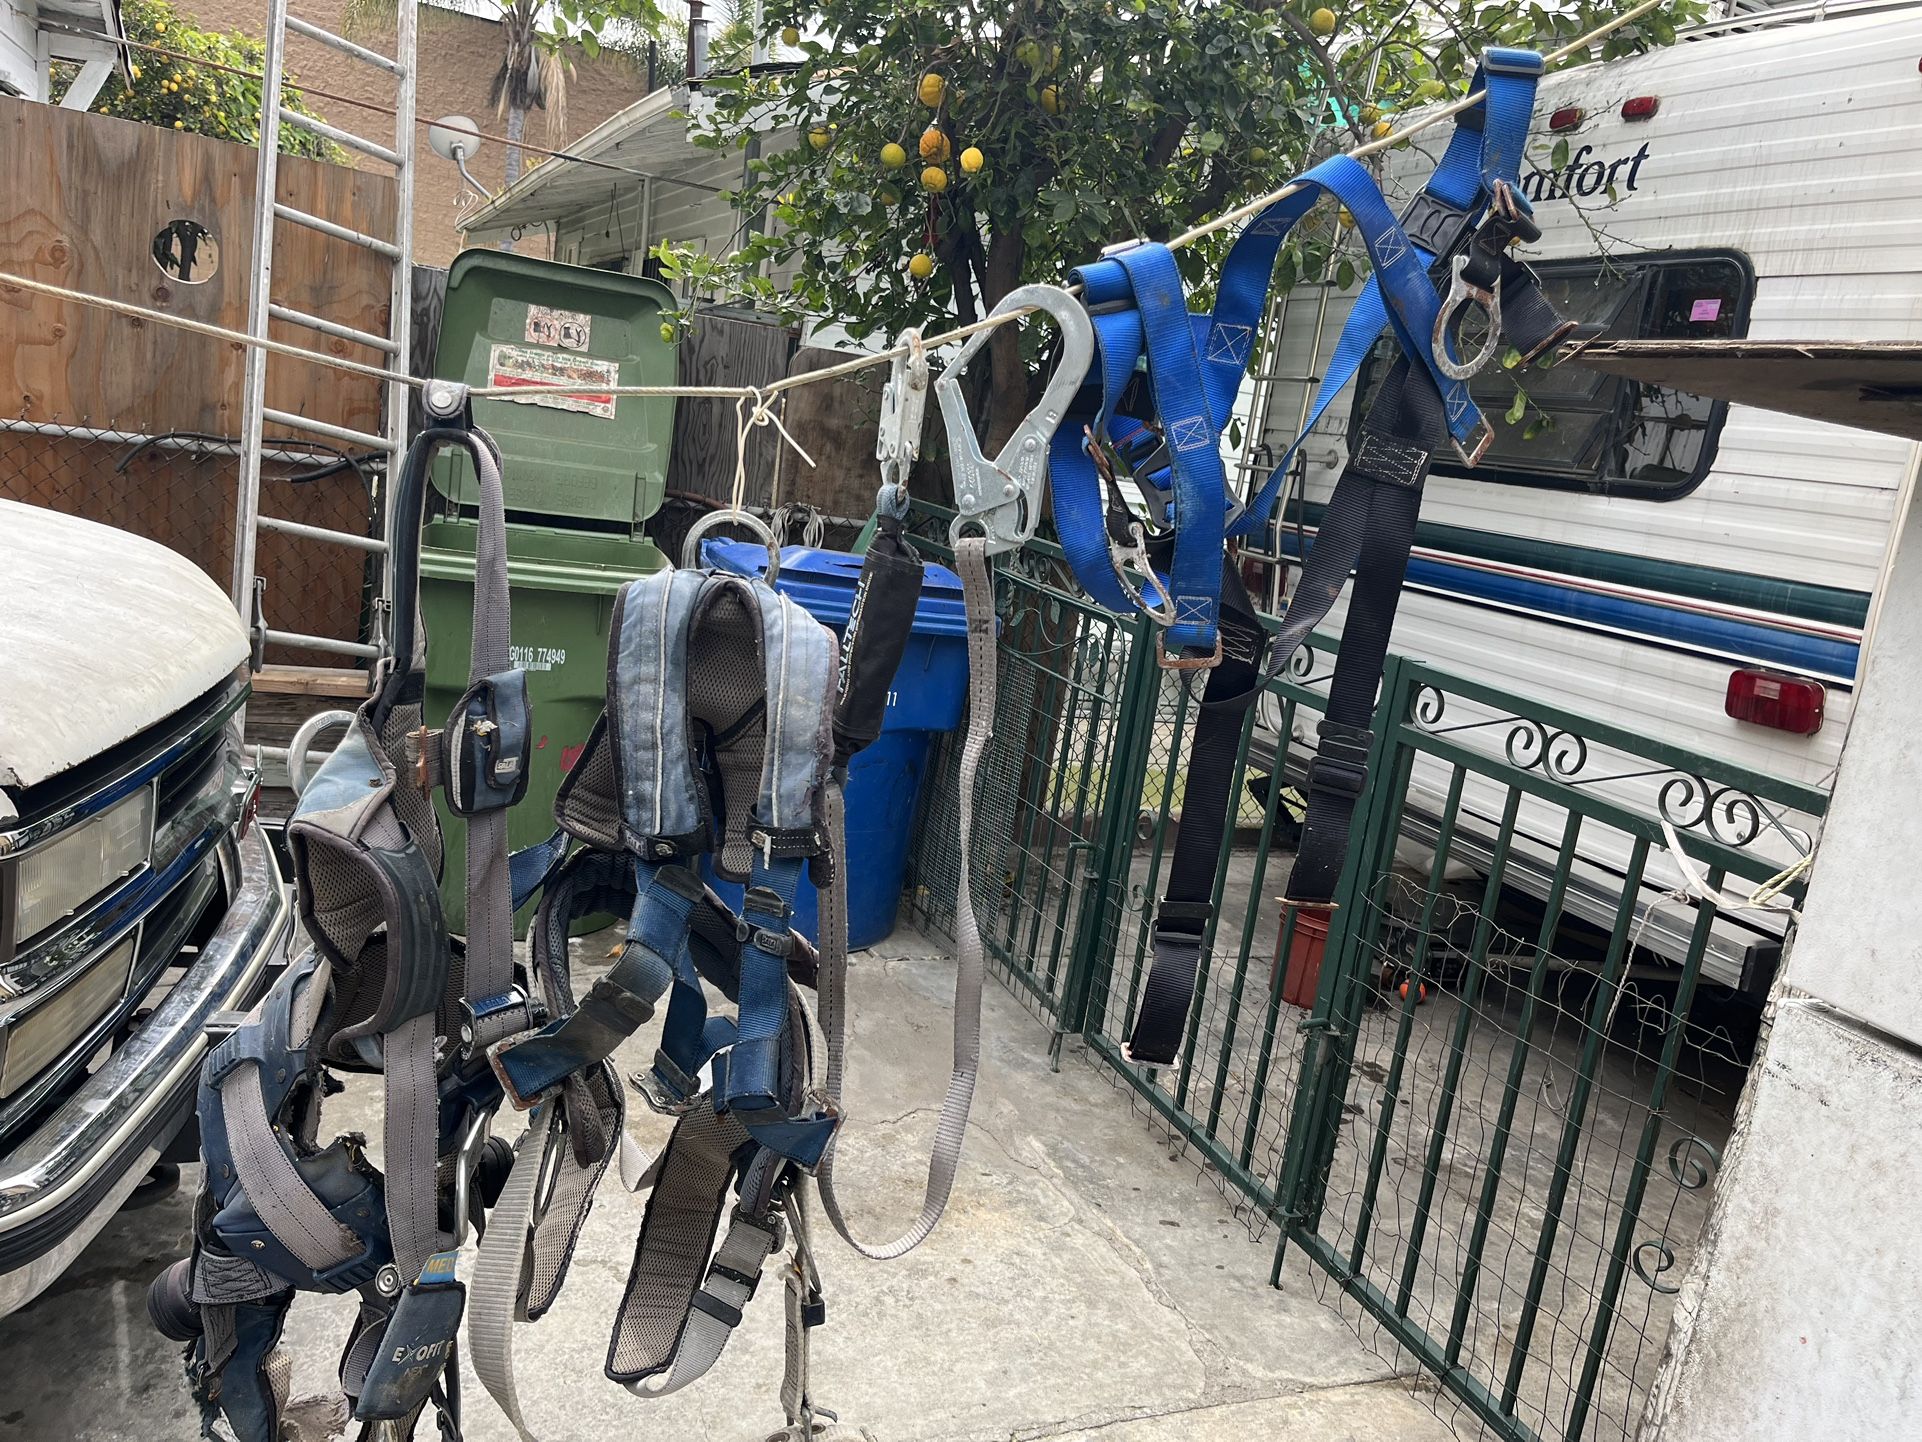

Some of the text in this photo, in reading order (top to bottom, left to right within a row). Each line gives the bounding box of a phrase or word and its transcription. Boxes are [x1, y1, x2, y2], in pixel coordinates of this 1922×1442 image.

[1517, 141, 1650, 203] mfort
[509, 645, 566, 665] G0116 774949
